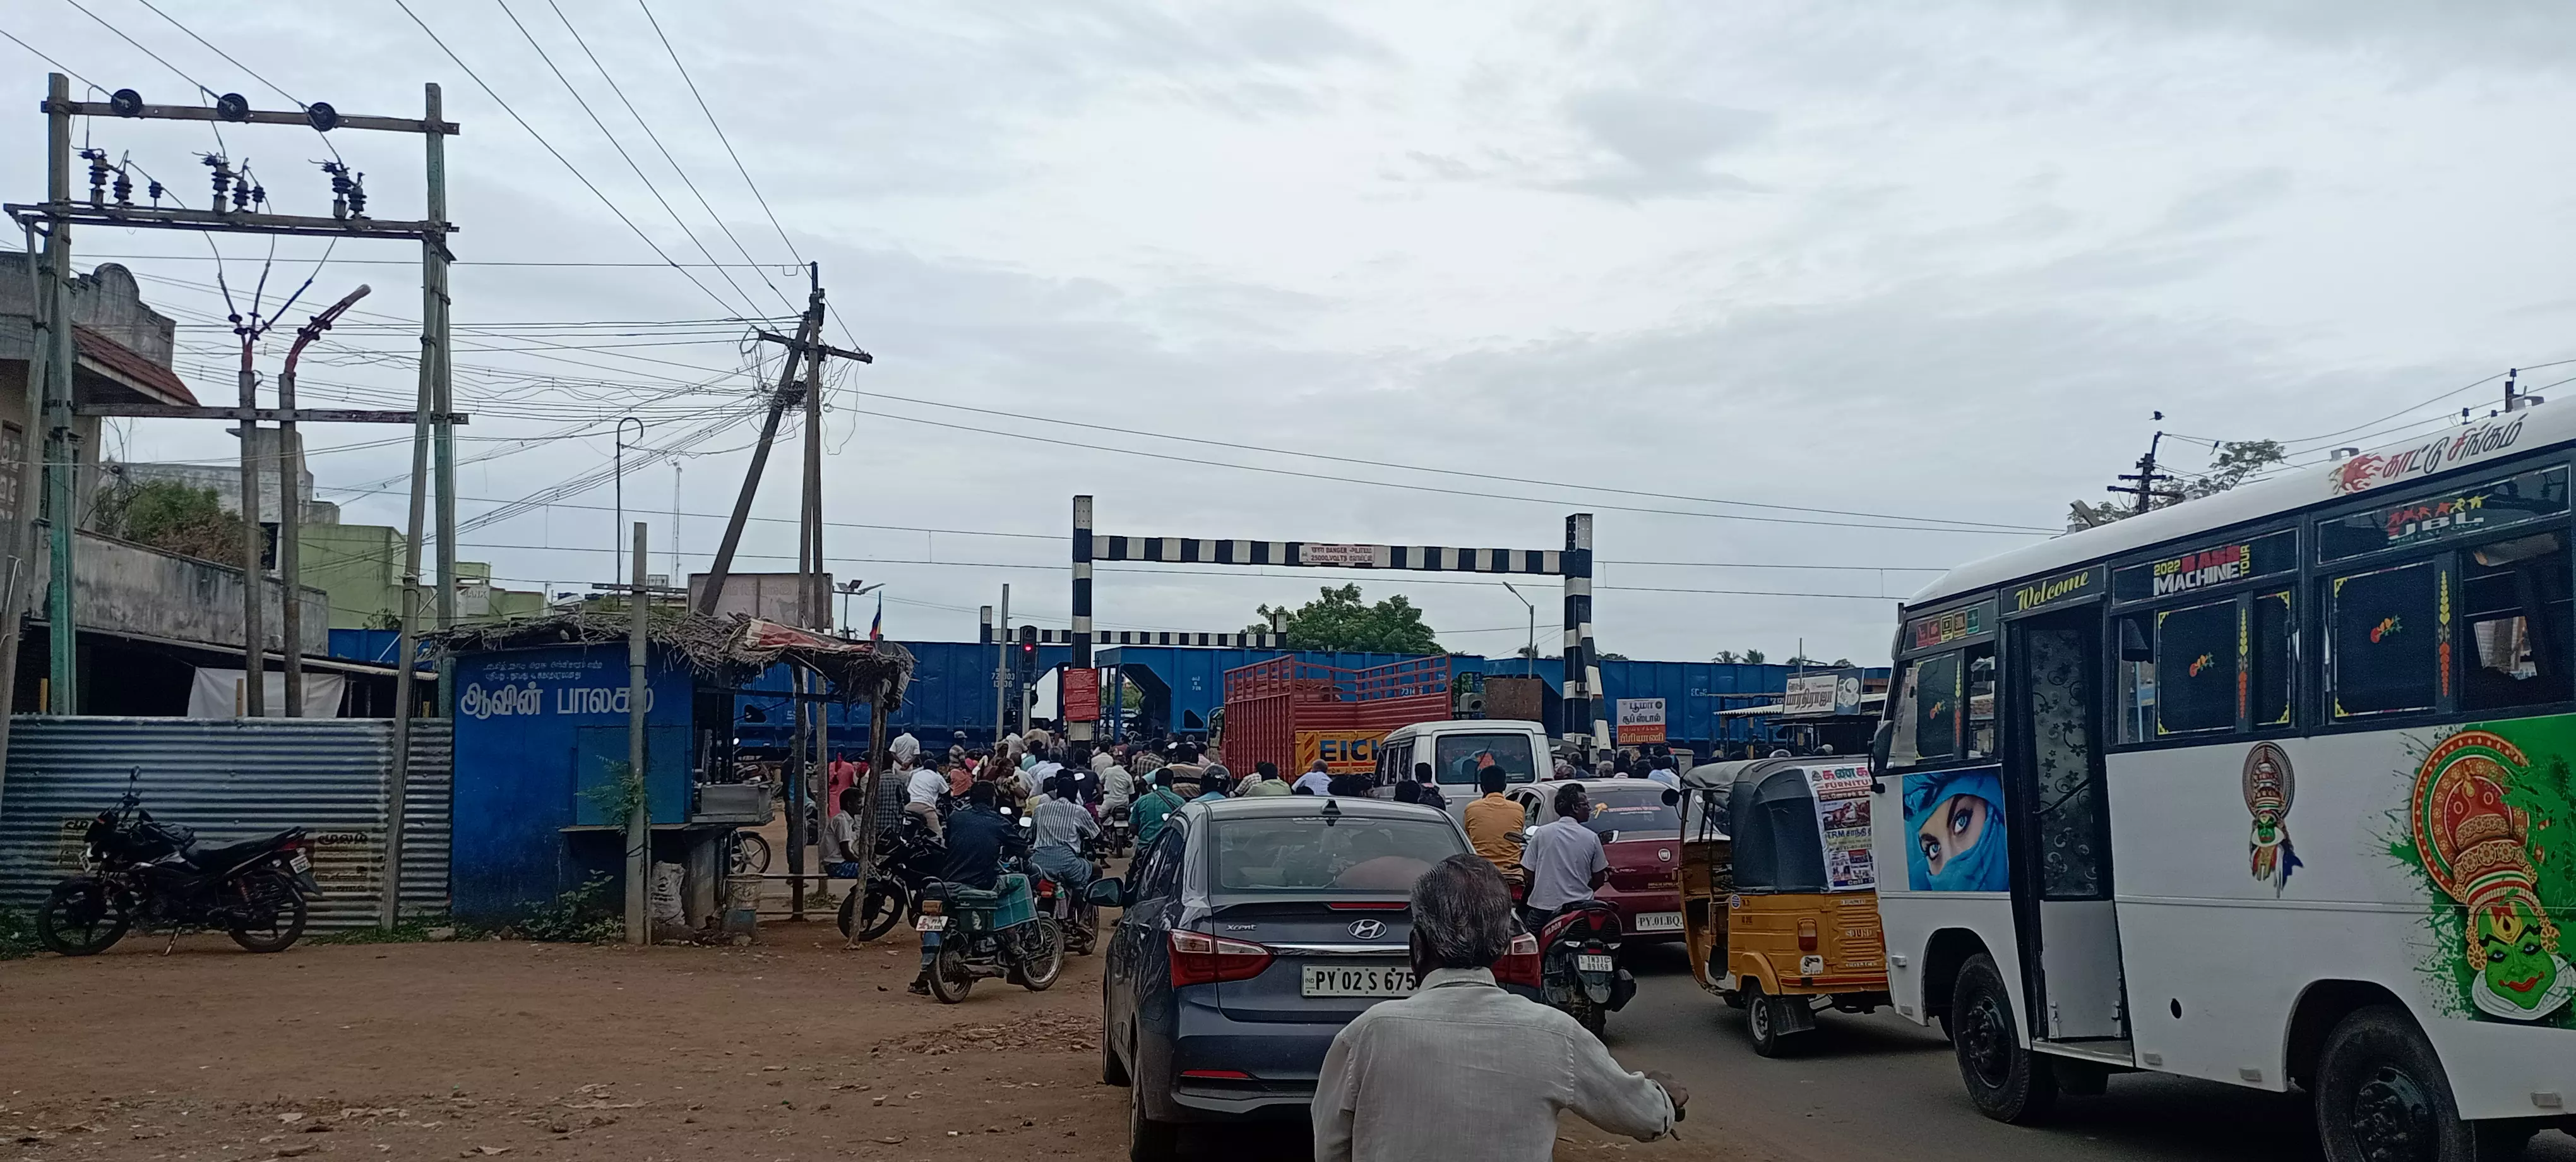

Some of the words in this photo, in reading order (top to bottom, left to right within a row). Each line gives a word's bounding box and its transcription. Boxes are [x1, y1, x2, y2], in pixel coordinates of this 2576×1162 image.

[2382, 436, 2450, 481] காட்டு
[2447, 412, 2529, 464] சிங்கம்
[2388, 512, 2484, 541] JBL
[2154, 560, 2181, 576] 2022
[2240, 544, 2250, 577] TOUR
[2014, 572, 2090, 612] Welcome
[2153, 561, 2240, 596] MACHINE
[460, 681, 544, 719] ஆவின்
[1629, 702, 1654, 713] பூமா
[1619, 732, 1664, 743] பிரியாணி
[1316, 971, 1335, 990] PY
[1342, 971, 1362, 990] 02
[1368, 971, 1377, 990] S
[1384, 972, 1415, 991] 675
